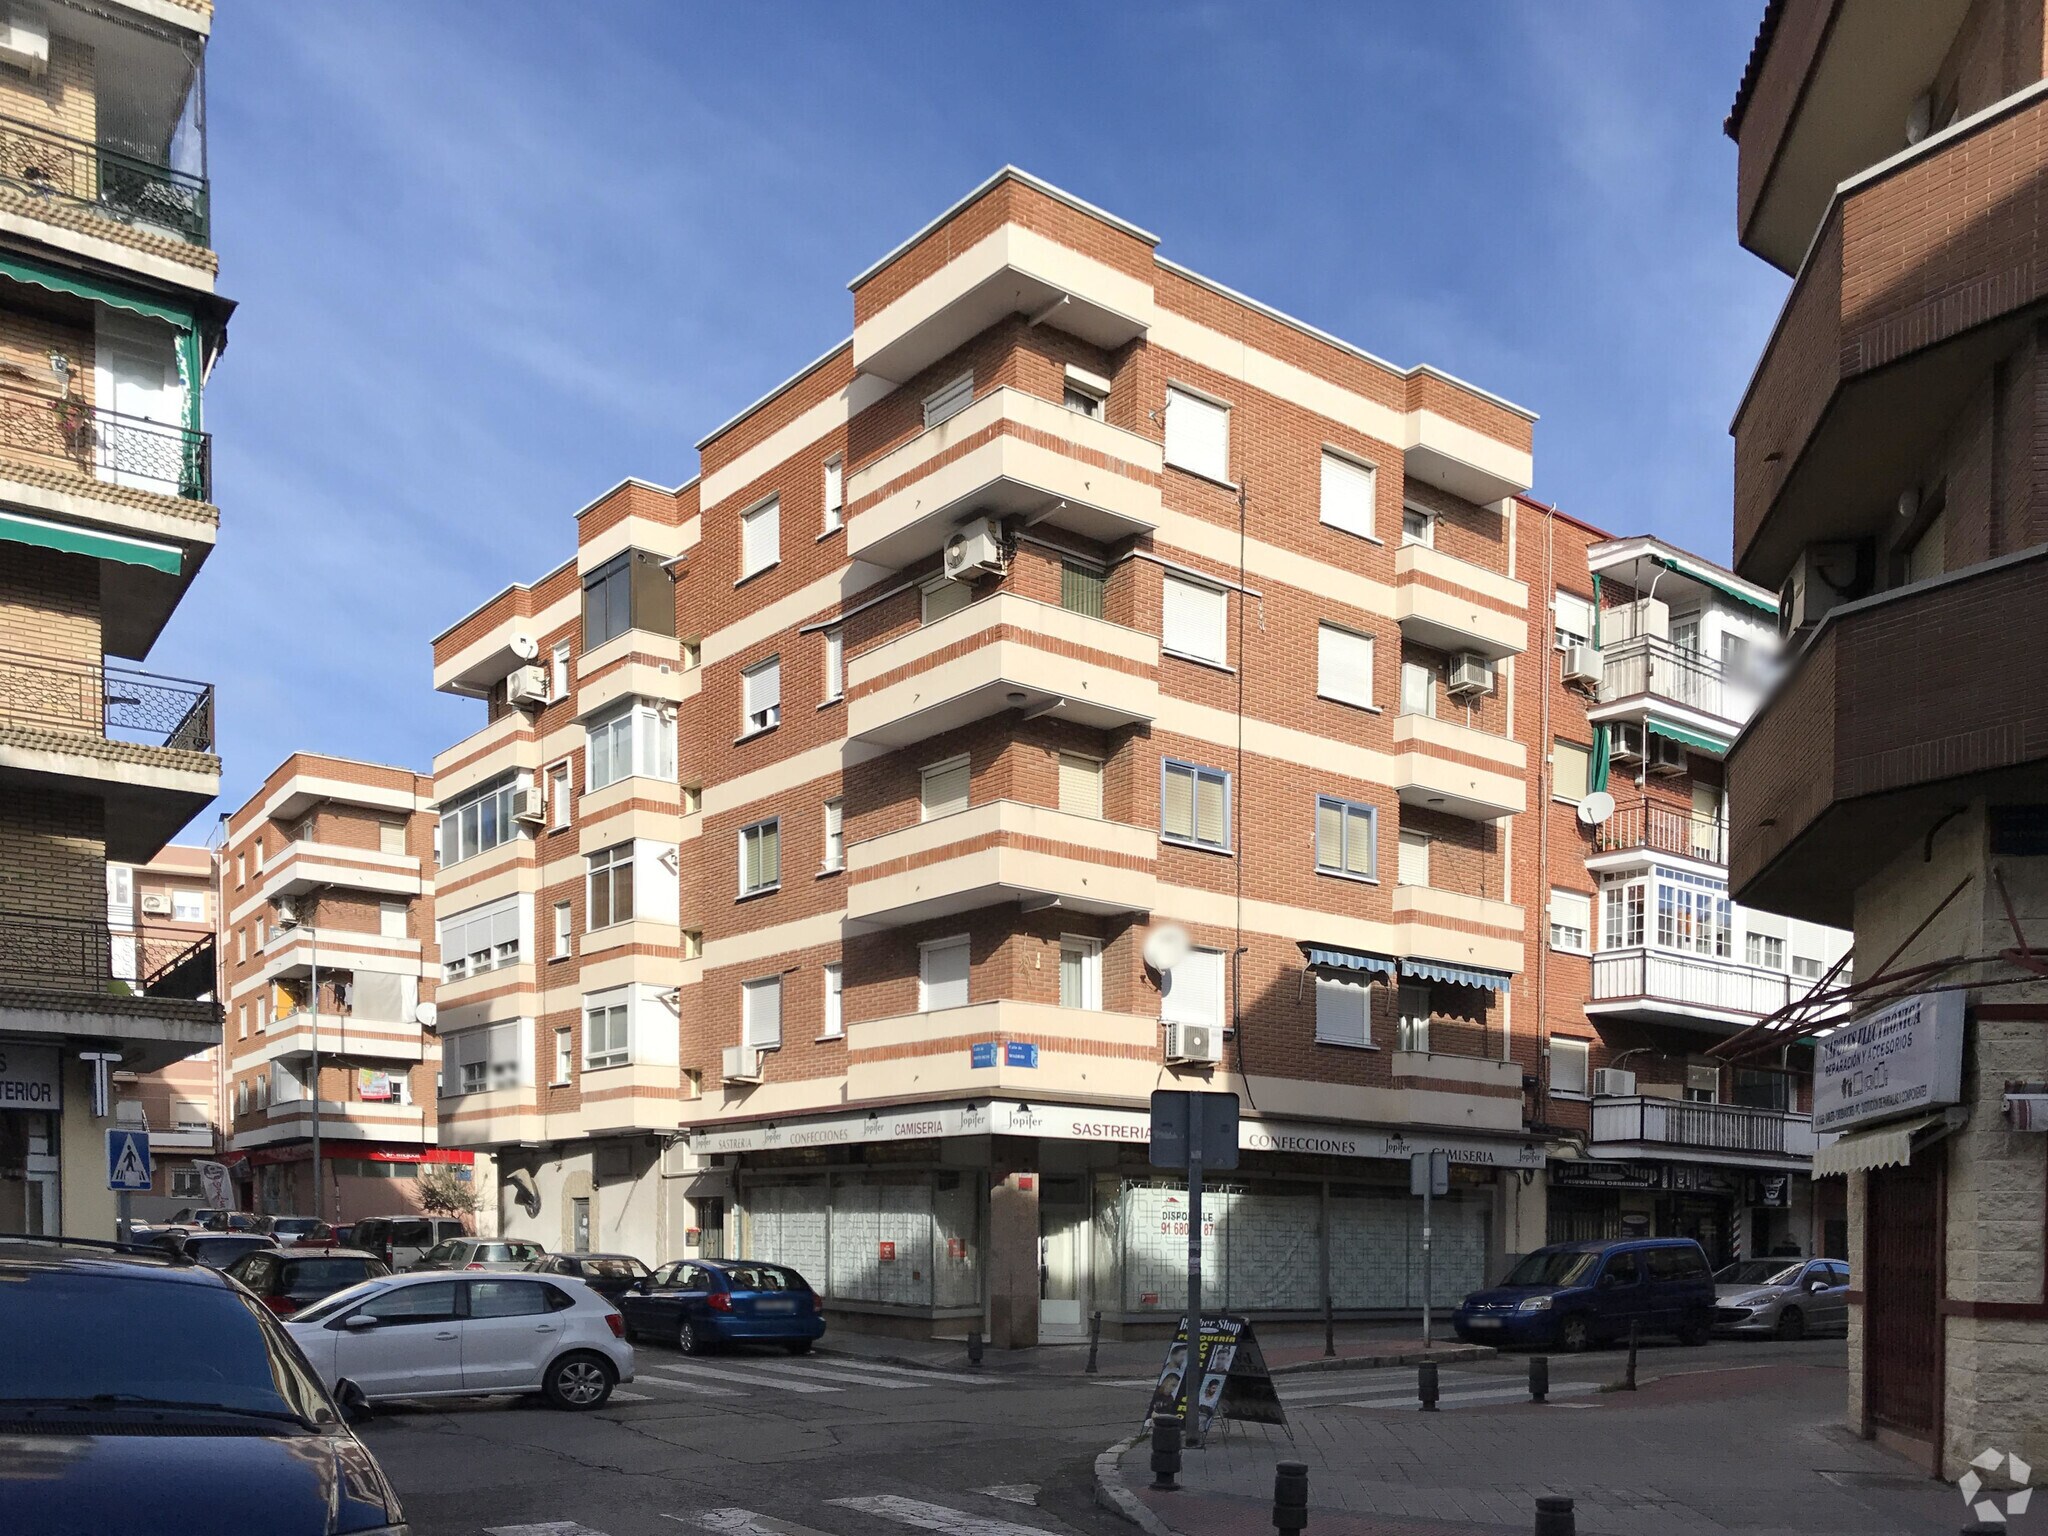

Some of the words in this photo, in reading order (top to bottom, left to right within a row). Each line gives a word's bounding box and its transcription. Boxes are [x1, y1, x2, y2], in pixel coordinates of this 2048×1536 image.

[1825, 1049, 1861, 1077] REPARACIÓN
[1861, 1049, 1867, 1064] Y
[1867, 1032, 1913, 1061] ACCESORIOS
[718, 1138, 752, 1149] SASTRERIA
[790, 1129, 848, 1145] CONFECCIONES
[863, 1119, 884, 1136] Jopifer
[894, 1121, 943, 1136] CAMISERIA
[960, 1111, 986, 1129] Jopifer
[1008, 1110, 1043, 1129] Jopifer
[1072, 1122, 1150, 1139] SASTRERIA
[1249, 1134, 1355, 1153] CONFECCIONES
[1384, 1138, 1411, 1155] Jopifer
[1162, 1211, 1213, 1222] DISPOLE
[1161, 1222, 1170, 1235] 91
[1174, 1222, 1189, 1235] 680
[1179, 1317, 1215, 1330] Bber
[1217, 1319, 1241, 1335] Shop
[1177, 1334, 1236, 1343] PEQUERÍA
